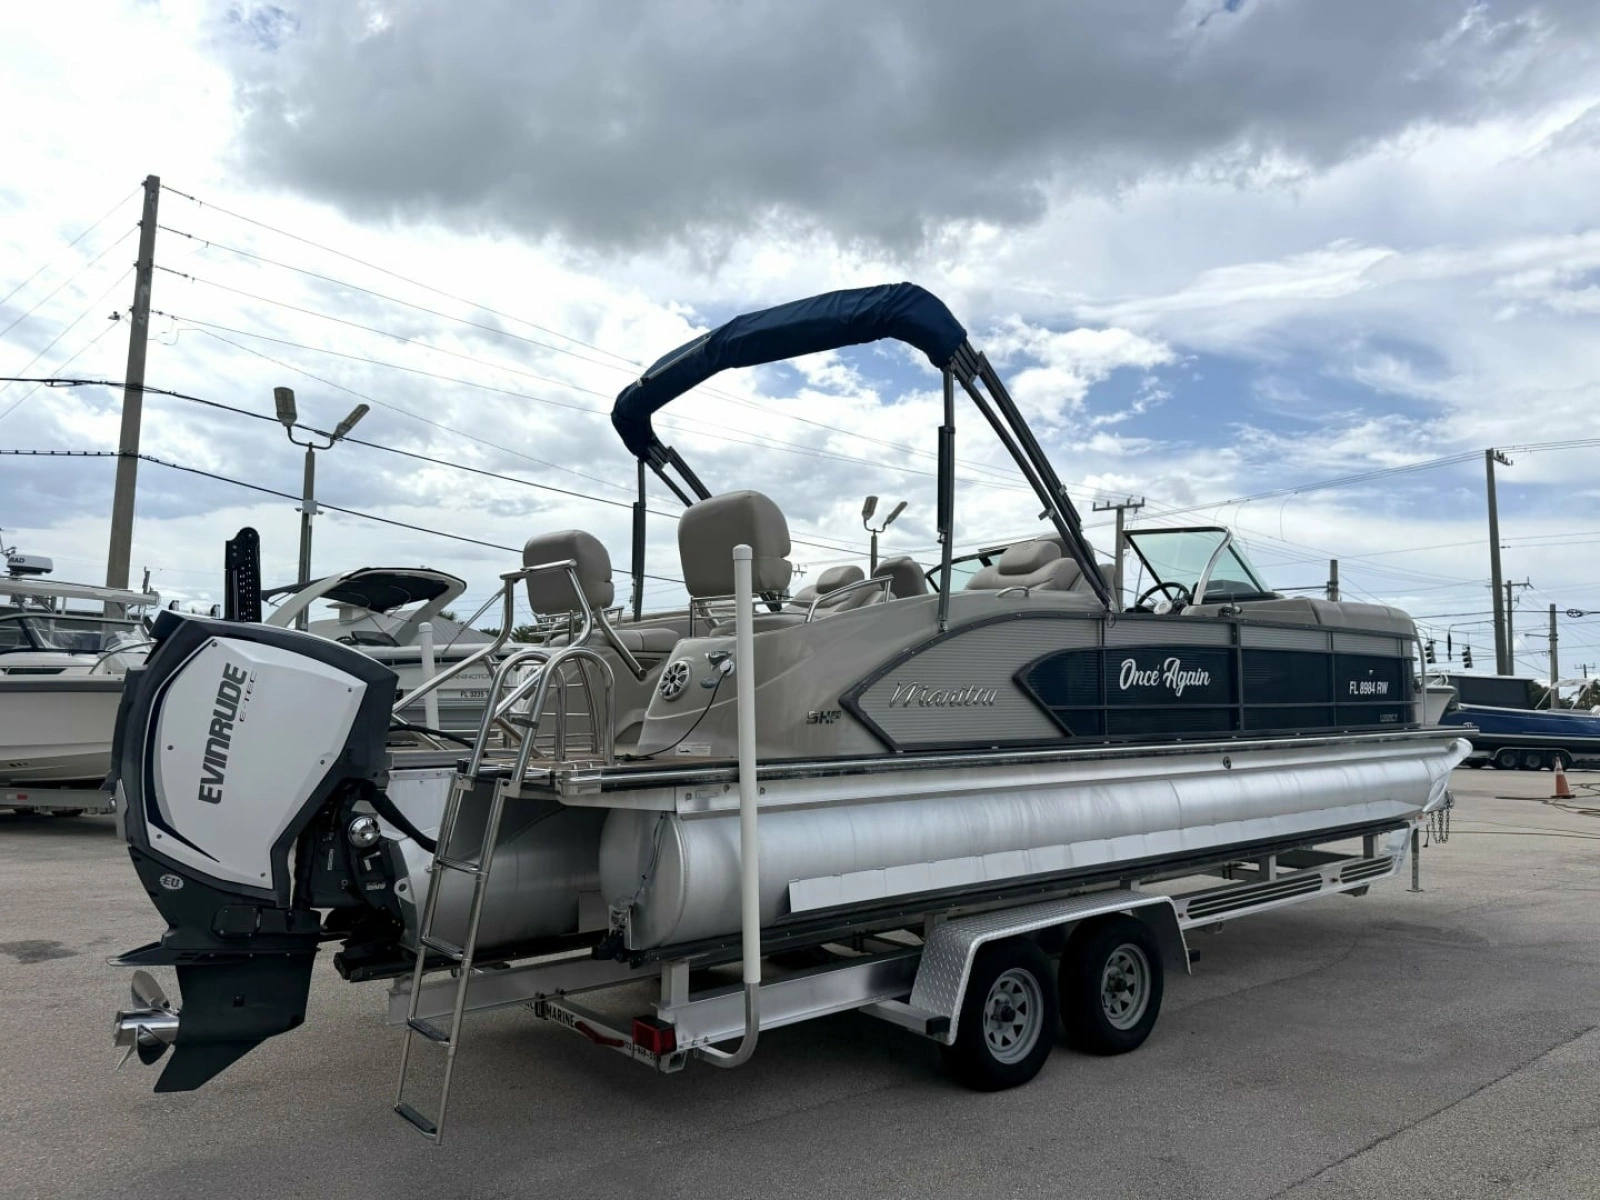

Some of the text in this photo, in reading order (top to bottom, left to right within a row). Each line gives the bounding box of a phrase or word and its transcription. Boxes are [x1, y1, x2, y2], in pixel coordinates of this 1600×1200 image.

[1119, 657, 1211, 698] Once Again
[1349, 681, 1389, 695] FL 8984 RW
[888, 681, 998, 708] Manitou
[806, 710, 842, 724] SHP
[198, 662, 248, 805] EVINRUDE
[546, 1003, 575, 1028] MARINE
